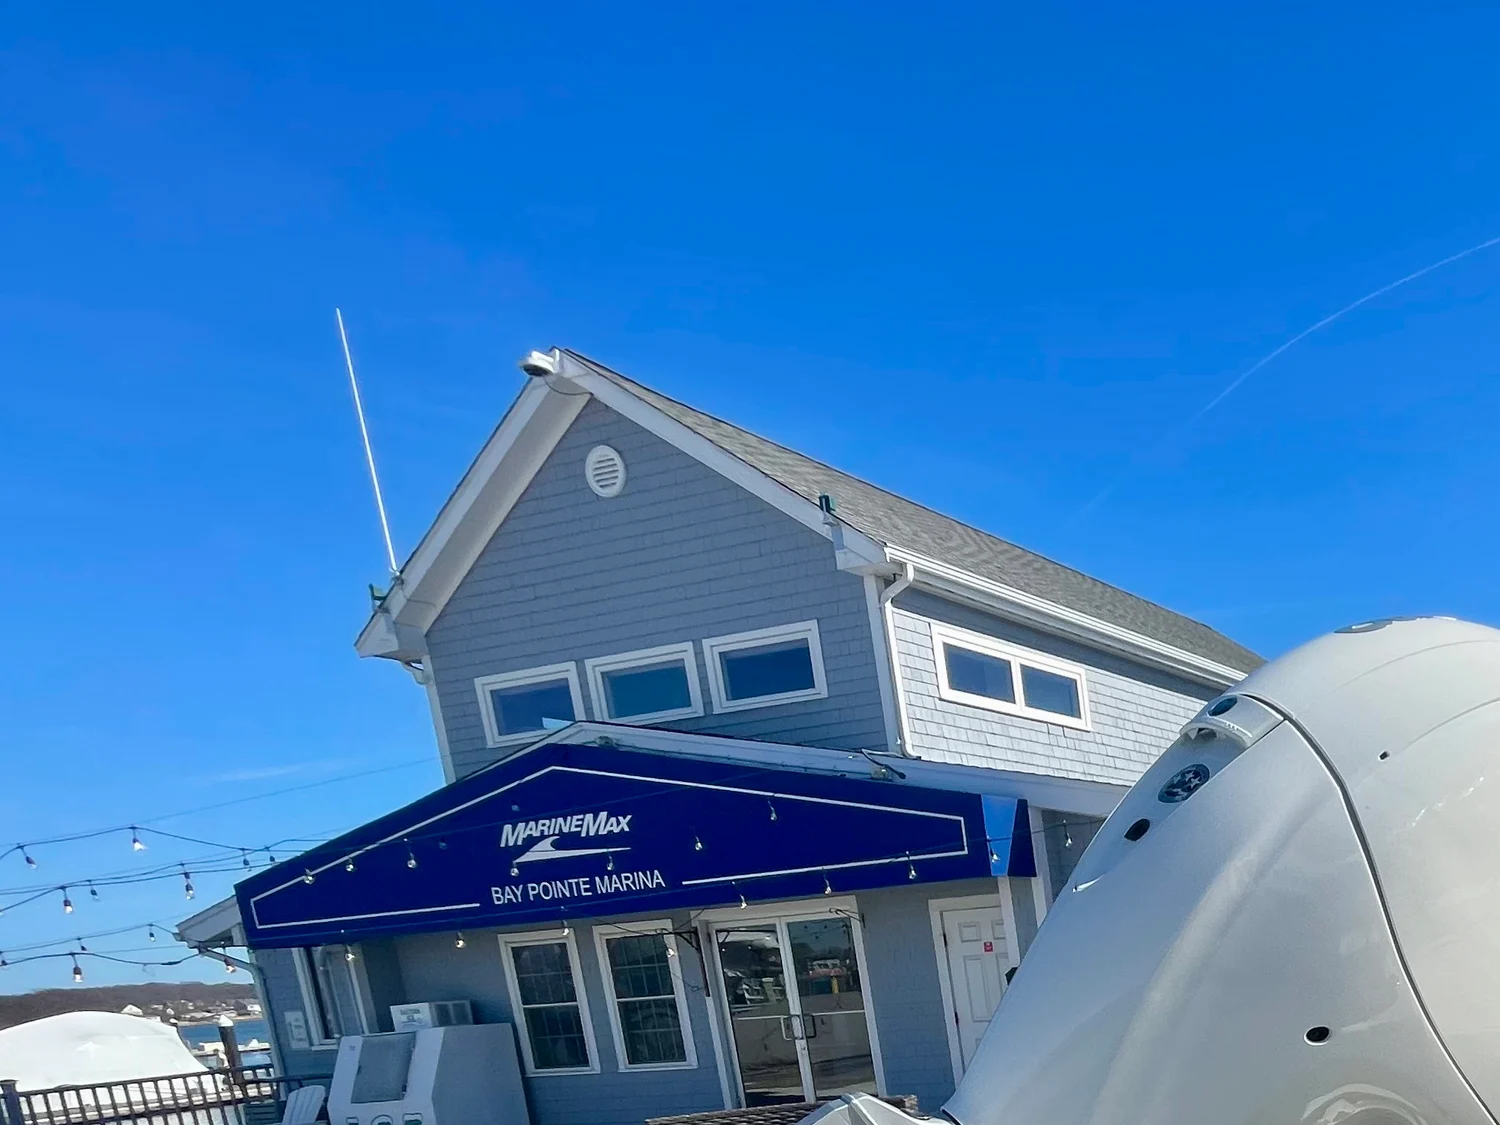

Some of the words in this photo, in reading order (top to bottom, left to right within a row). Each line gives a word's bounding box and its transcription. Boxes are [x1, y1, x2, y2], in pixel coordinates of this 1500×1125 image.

[500, 811, 633, 847] MARINEMAX
[491, 884, 523, 905] BAY
[527, 877, 593, 901] POINTE
[595, 869, 666, 894] MARINA
